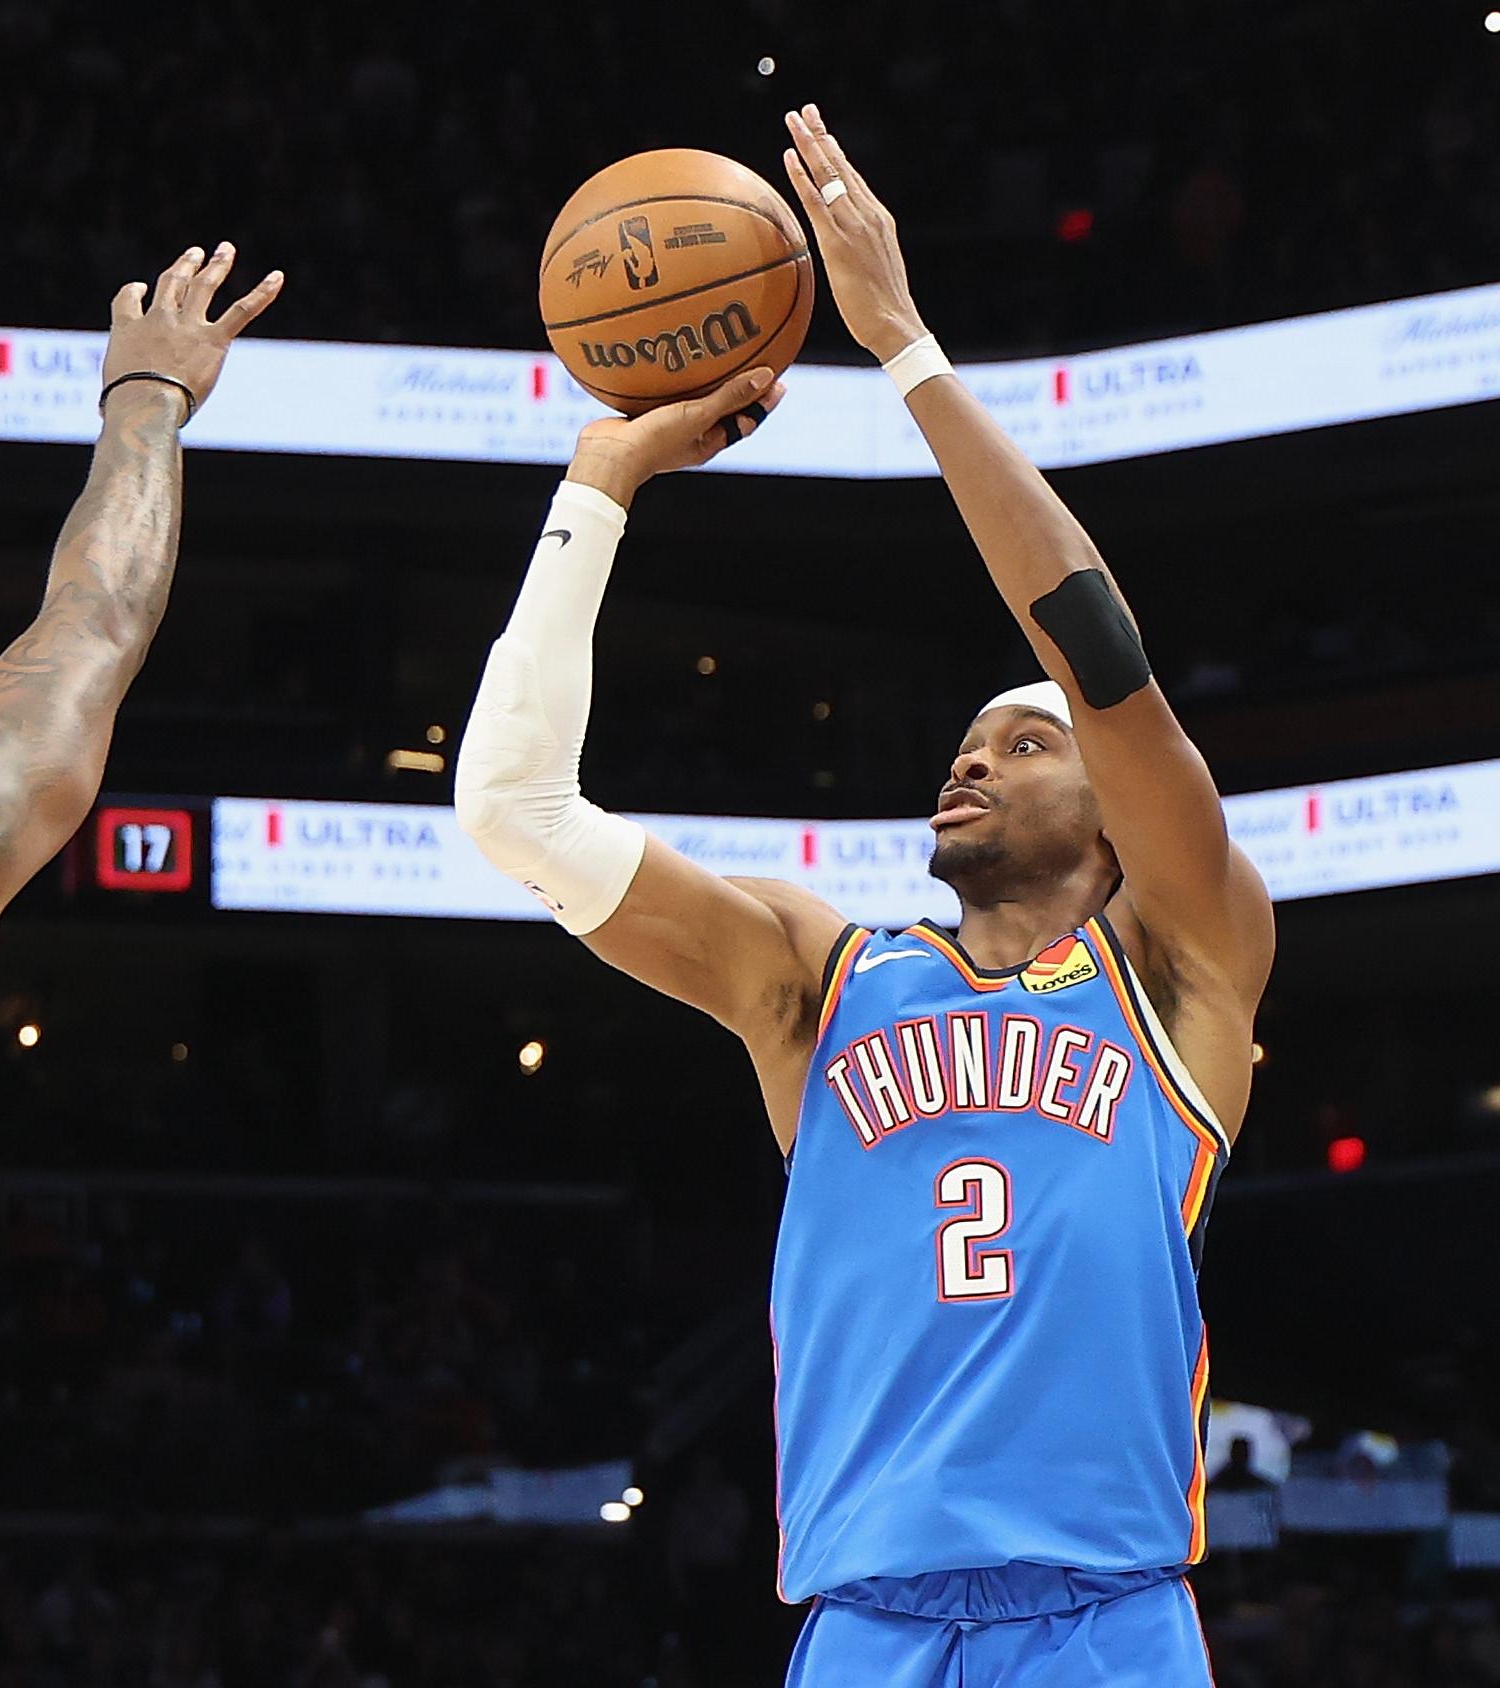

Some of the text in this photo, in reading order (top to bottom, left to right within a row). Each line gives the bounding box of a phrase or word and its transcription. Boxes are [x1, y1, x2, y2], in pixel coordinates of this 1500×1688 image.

[579, 299, 762, 373] Wilson
[28, 344, 102, 378] ULT
[1081, 355, 1204, 398] ULTRA
[1334, 782, 1460, 824] ULTRA
[121, 824, 171, 873] 17
[299, 817, 441, 849] ULTRA
[825, 1012, 1133, 1152] THUNDER
[934, 1157, 1015, 1302] 2
